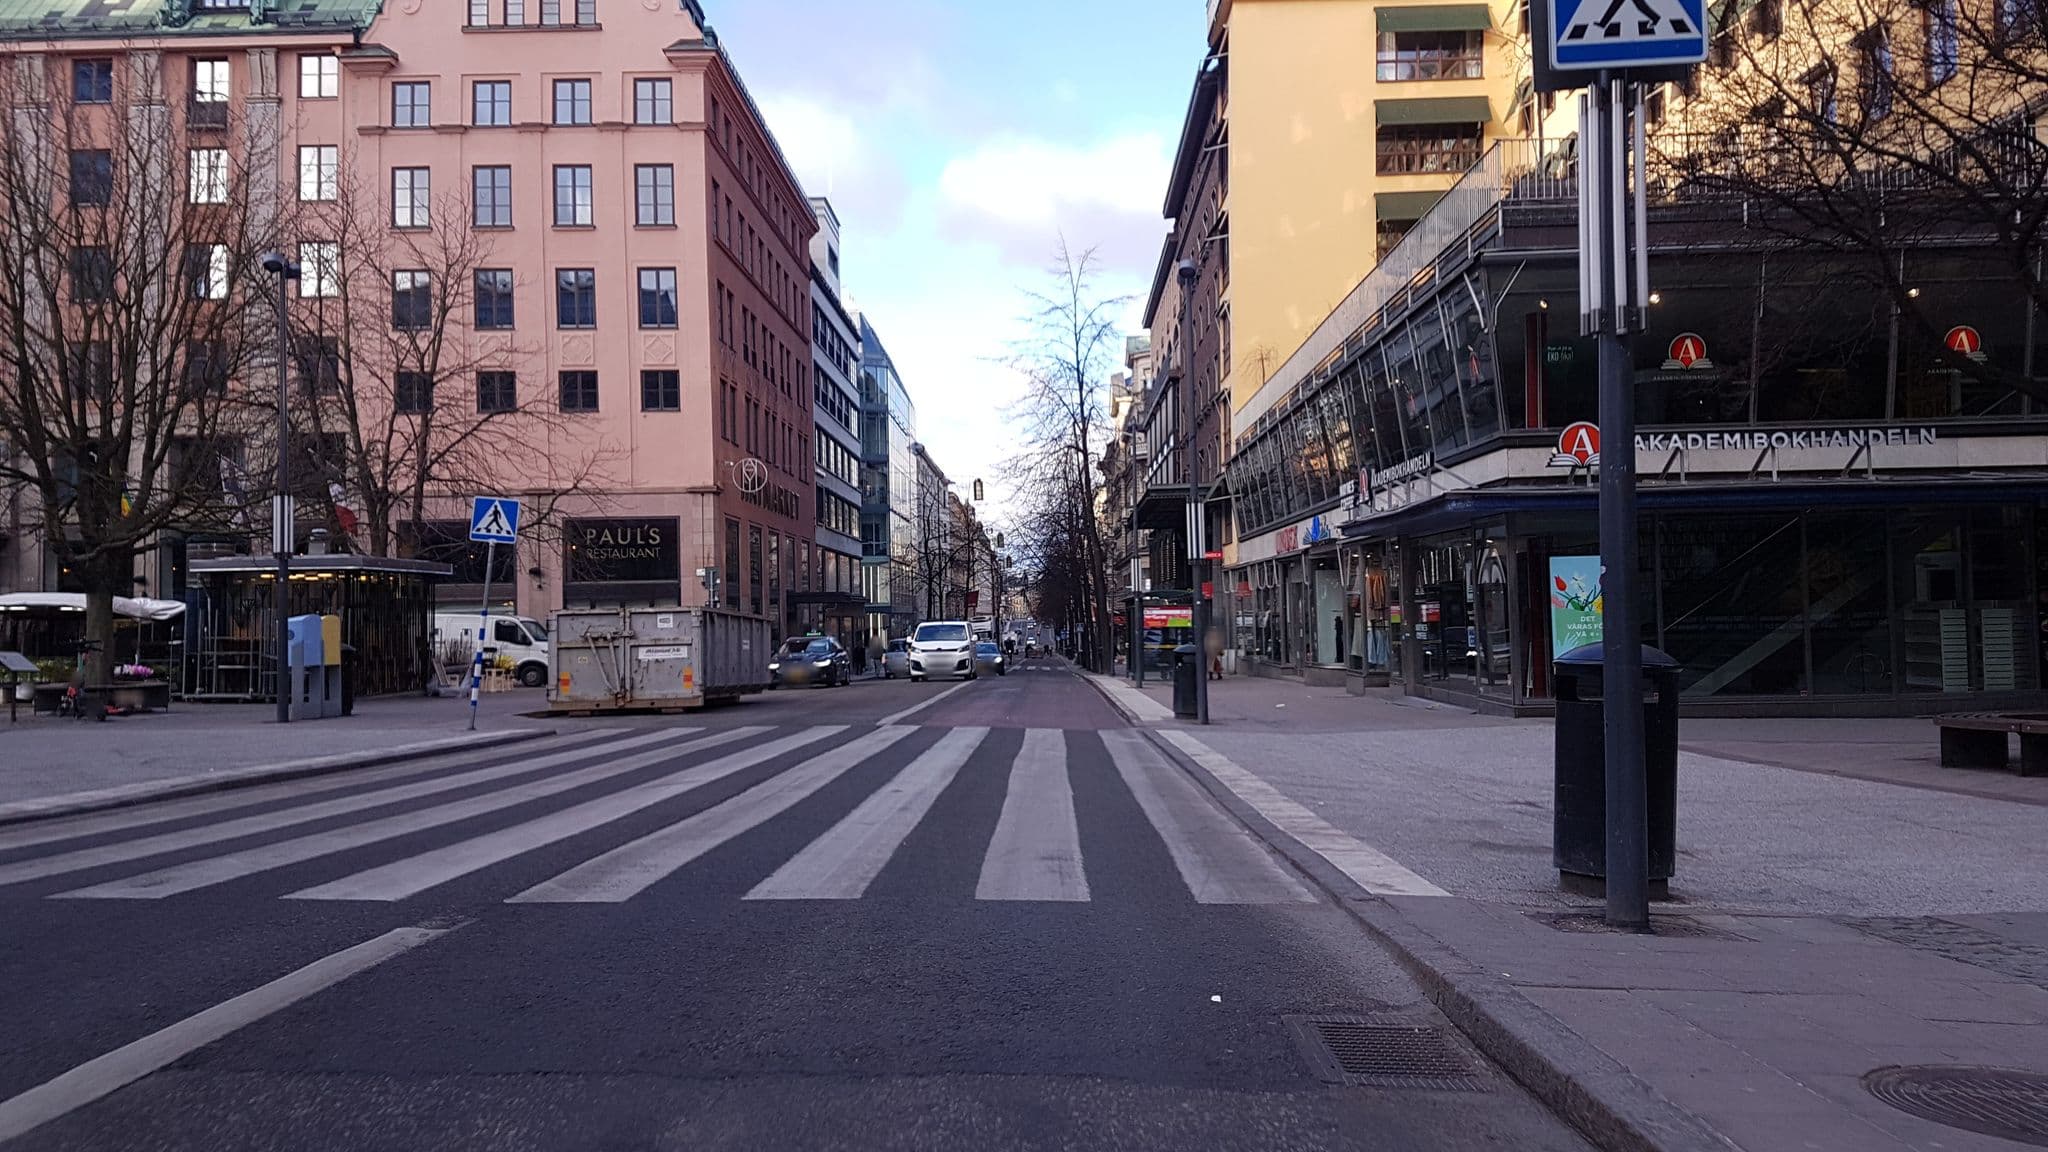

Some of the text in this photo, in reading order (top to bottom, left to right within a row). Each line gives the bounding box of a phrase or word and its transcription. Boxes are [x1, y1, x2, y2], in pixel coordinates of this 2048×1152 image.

[1679, 338, 1698, 361] A
[1571, 428, 1595, 455] A
[1635, 427, 1937, 451] AKADEMIBOKHANDELN
[586, 525, 661, 545] PAUL'S
[586, 547, 661, 560] RESTAURANT
